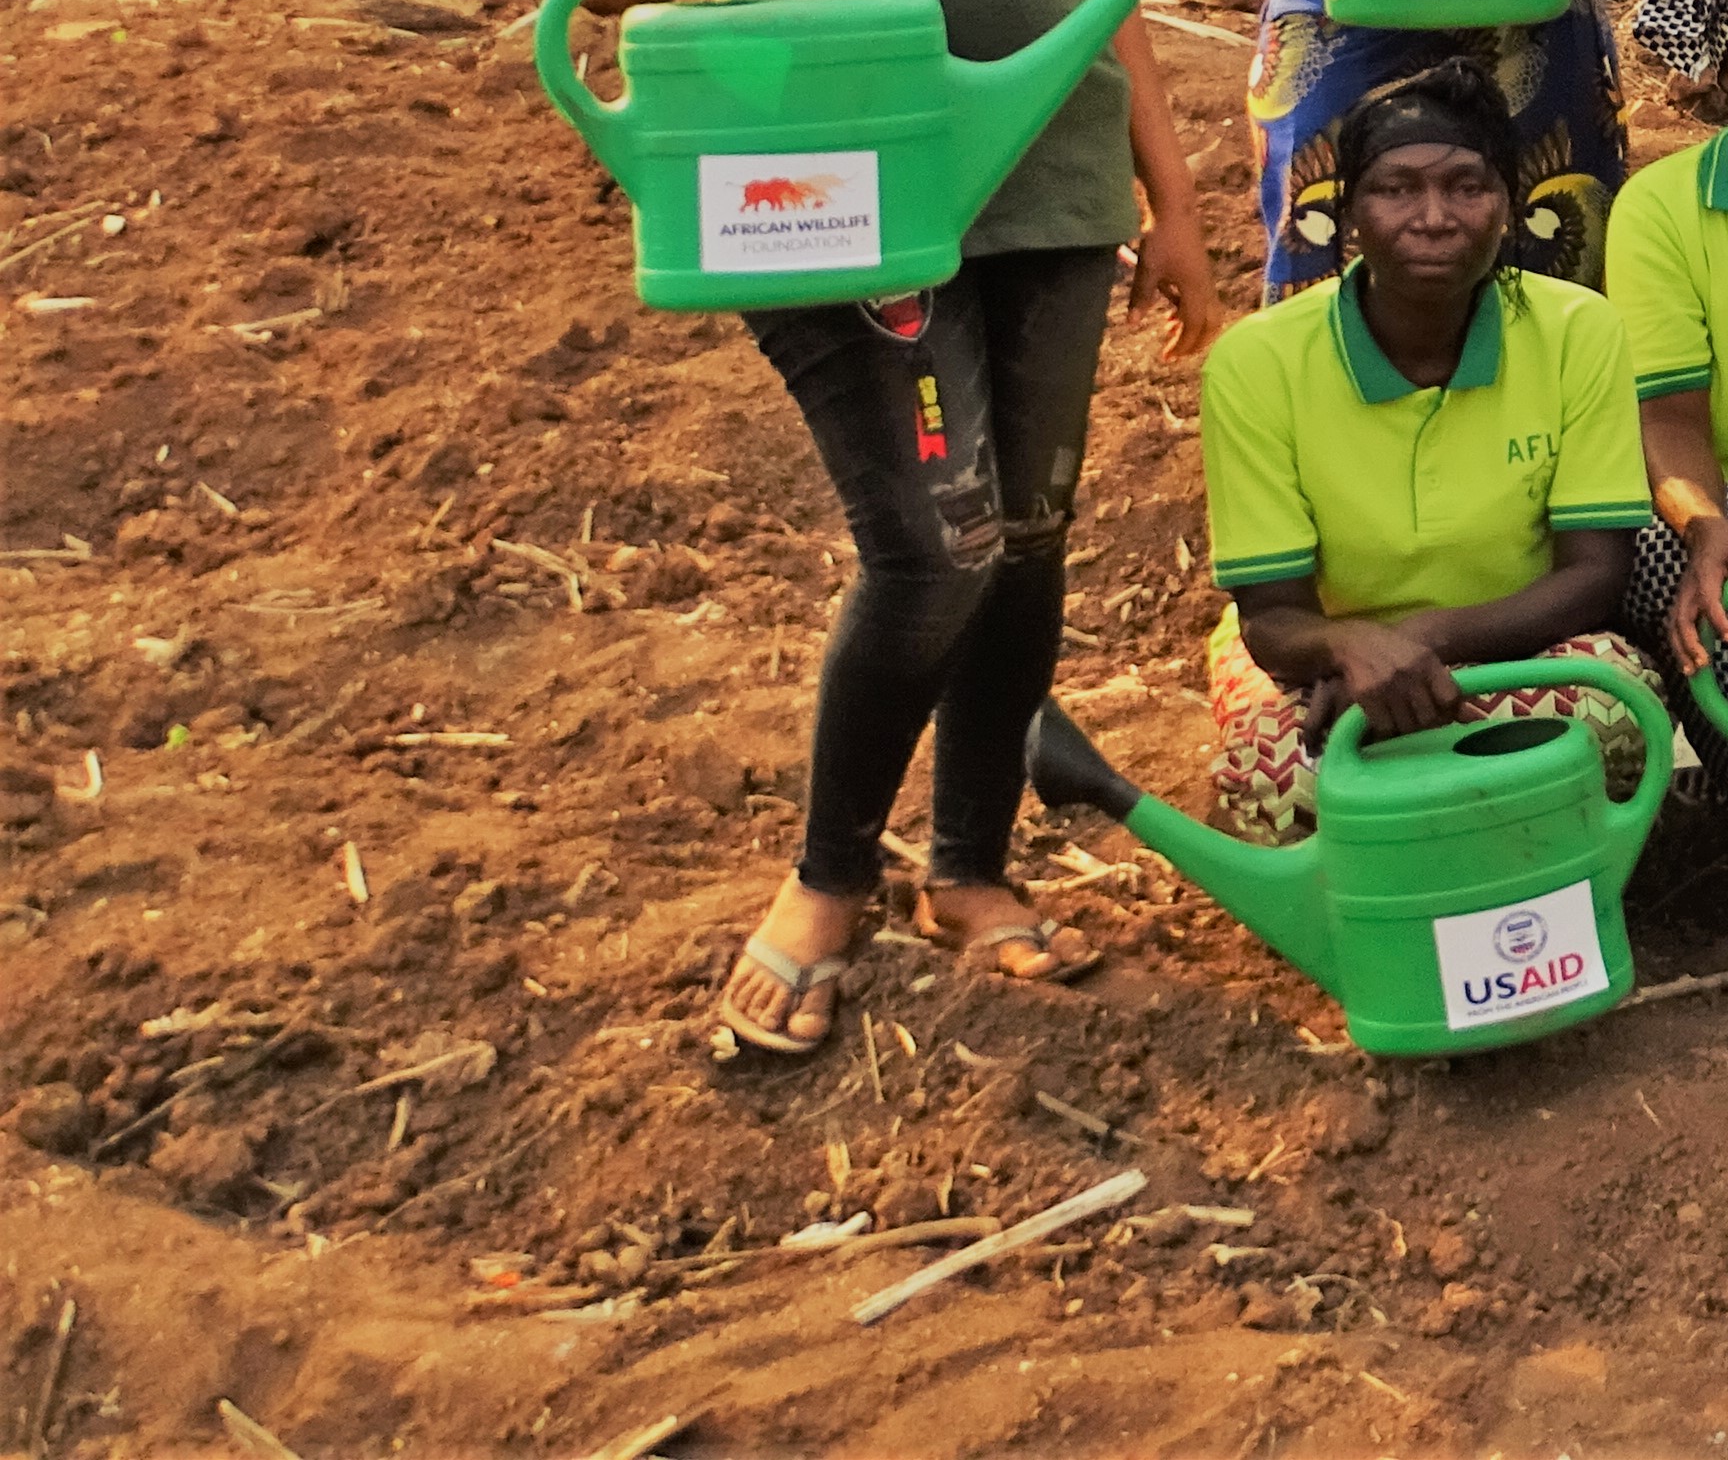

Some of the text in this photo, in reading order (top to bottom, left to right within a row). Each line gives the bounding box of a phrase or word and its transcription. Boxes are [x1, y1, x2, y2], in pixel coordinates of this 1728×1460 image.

[719, 214, 871, 236] AFRICAN WILDLIFE
[1507, 433, 1558, 464] AFL
[1463, 952, 1585, 1005] USAID
